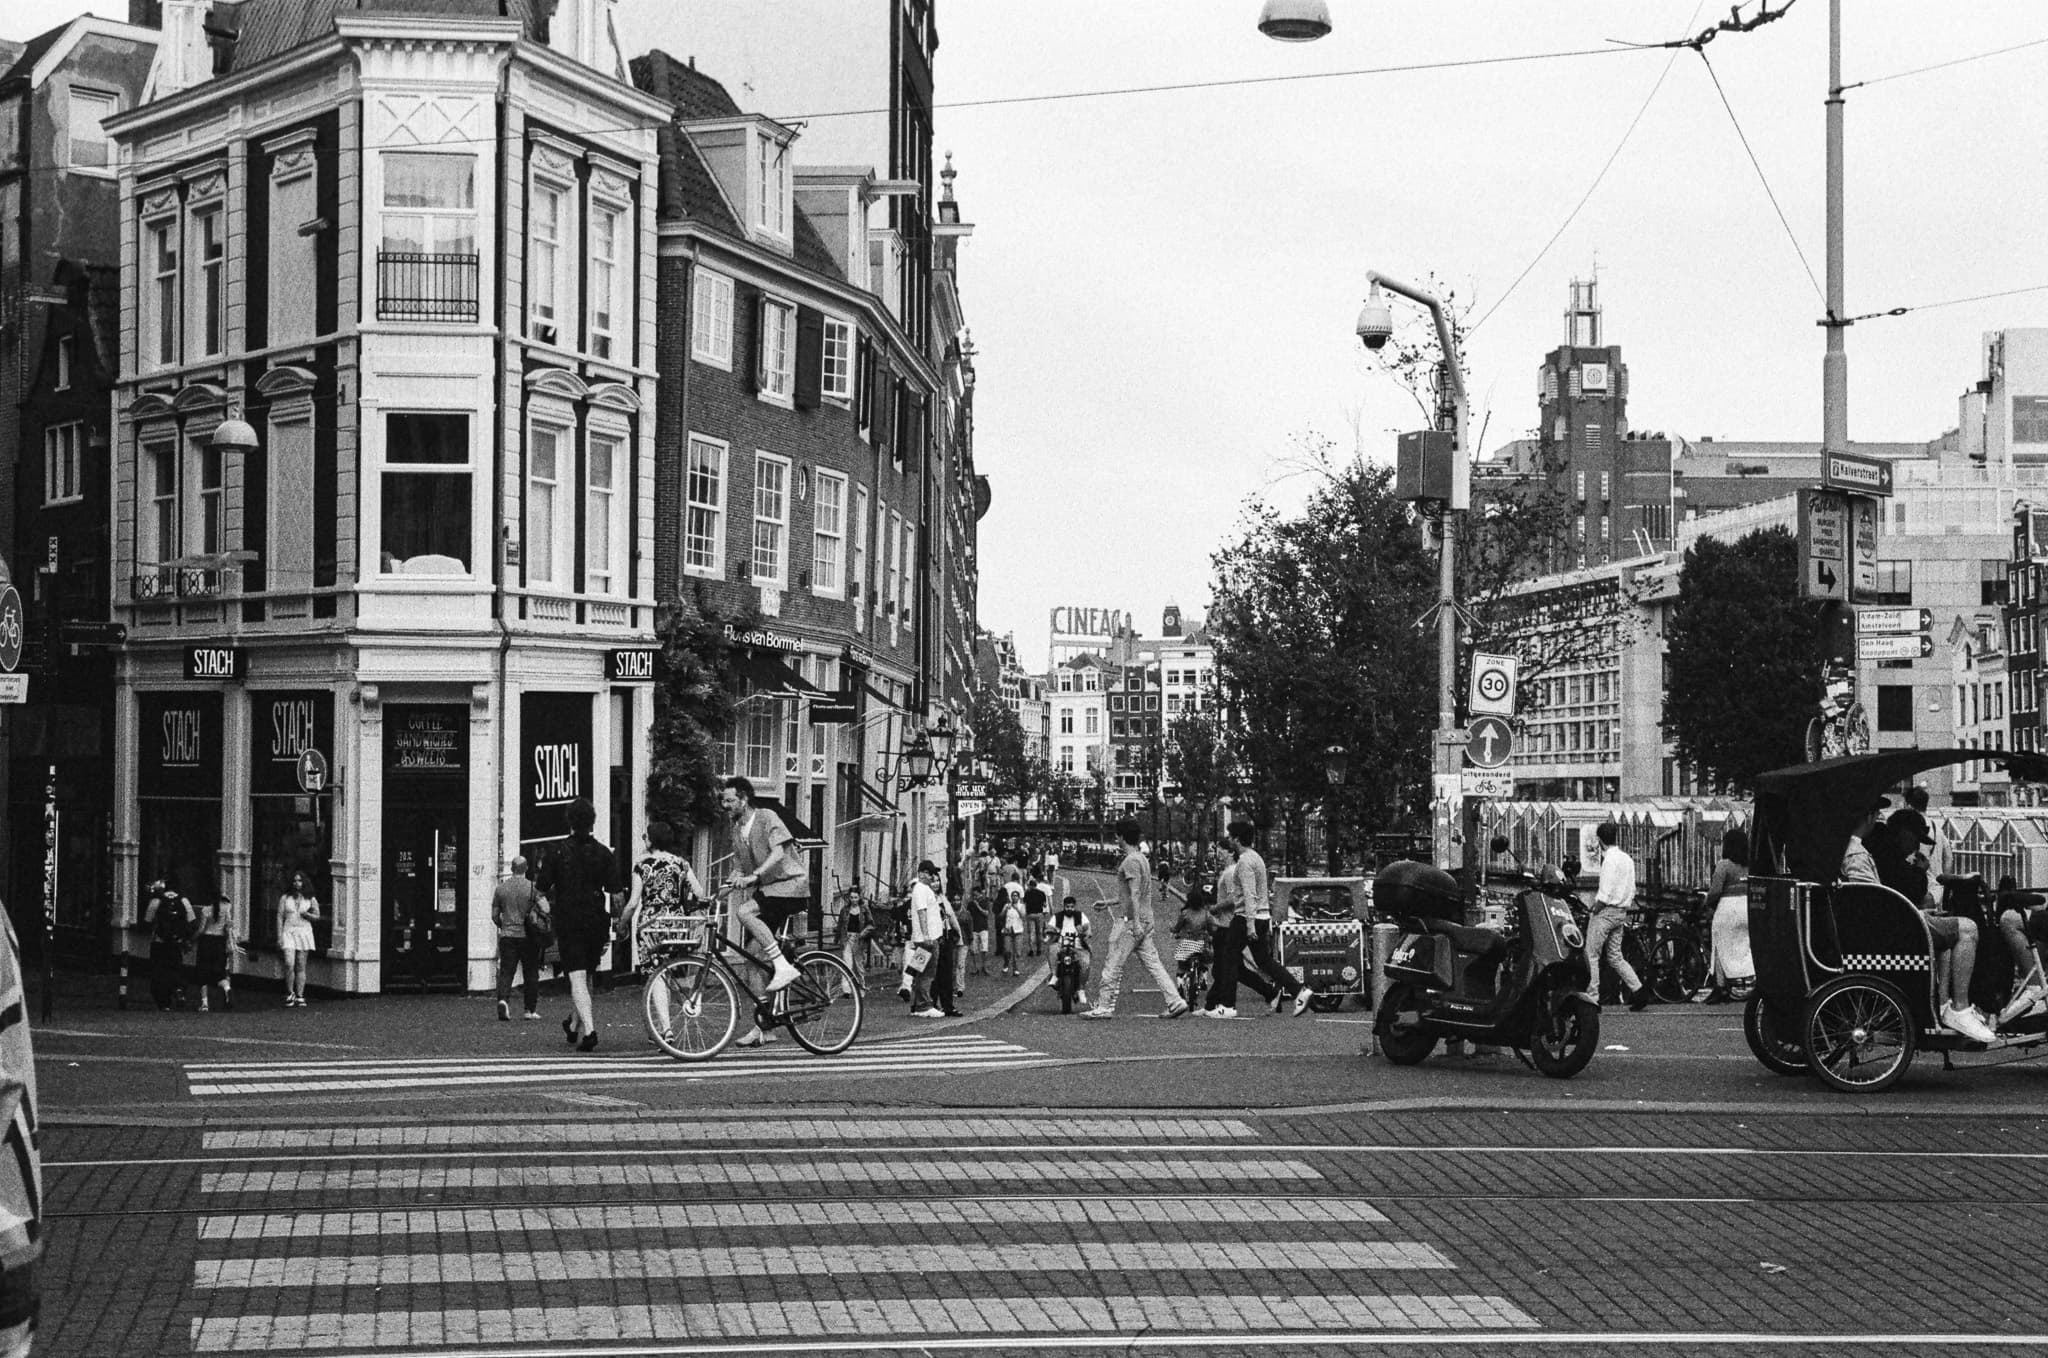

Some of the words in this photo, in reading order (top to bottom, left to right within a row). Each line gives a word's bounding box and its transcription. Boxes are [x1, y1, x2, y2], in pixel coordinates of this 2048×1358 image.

[750, 631, 766, 646] van
[766, 631, 803, 653] Bommel
[194, 649, 234, 675] STACH
[615, 651, 653, 676] STACH
[1486, 658, 1505, 667] ZONE
[1483, 677, 1505, 692] 30
[162, 709, 200, 761] STACH
[272, 700, 314, 756] STACH
[534, 743, 580, 800] STACH
[1462, 771, 1511, 782] uitgezonderd
